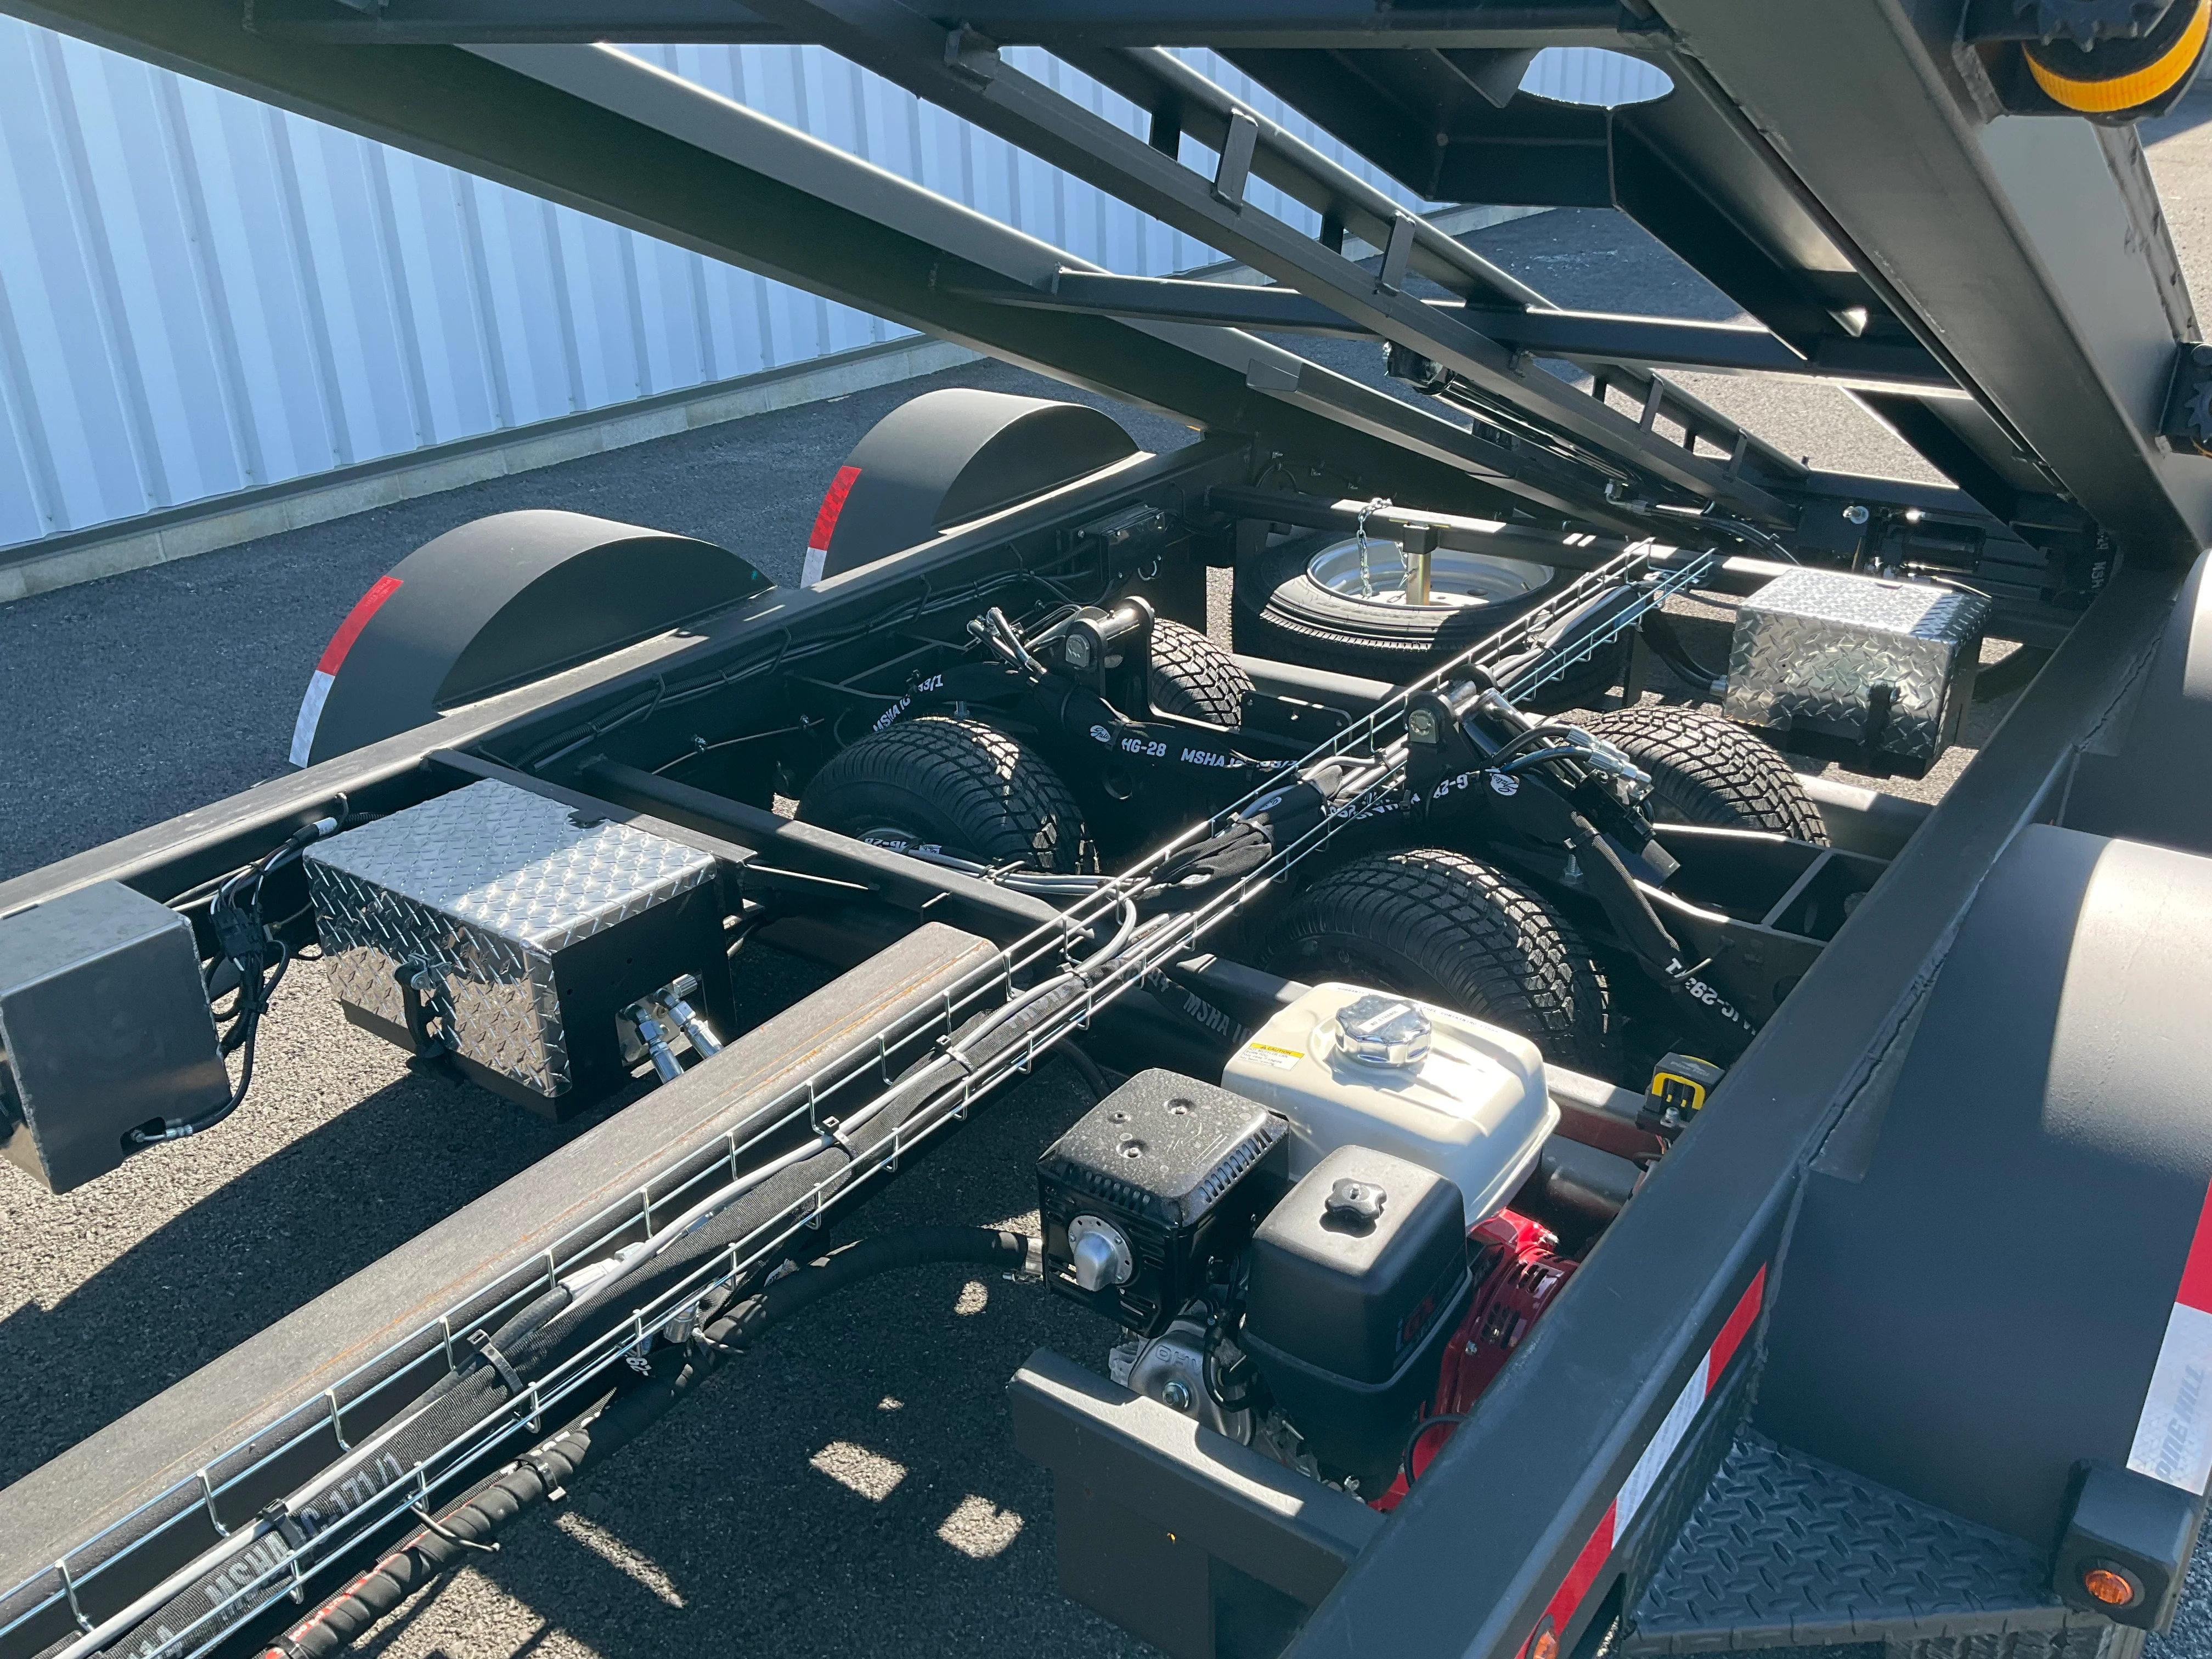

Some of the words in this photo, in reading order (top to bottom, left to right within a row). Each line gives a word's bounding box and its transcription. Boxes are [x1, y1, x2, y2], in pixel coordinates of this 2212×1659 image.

[872, 704, 901, 732] MSHA
[1121, 737, 1167, 757] HG-28
[1181, 748, 1225, 767] MSHA
[1492, 774, 1518, 795] Gates
[1183, 991, 1230, 1036] MSHA
[1267, 1047, 1292, 1055] CAUTION
